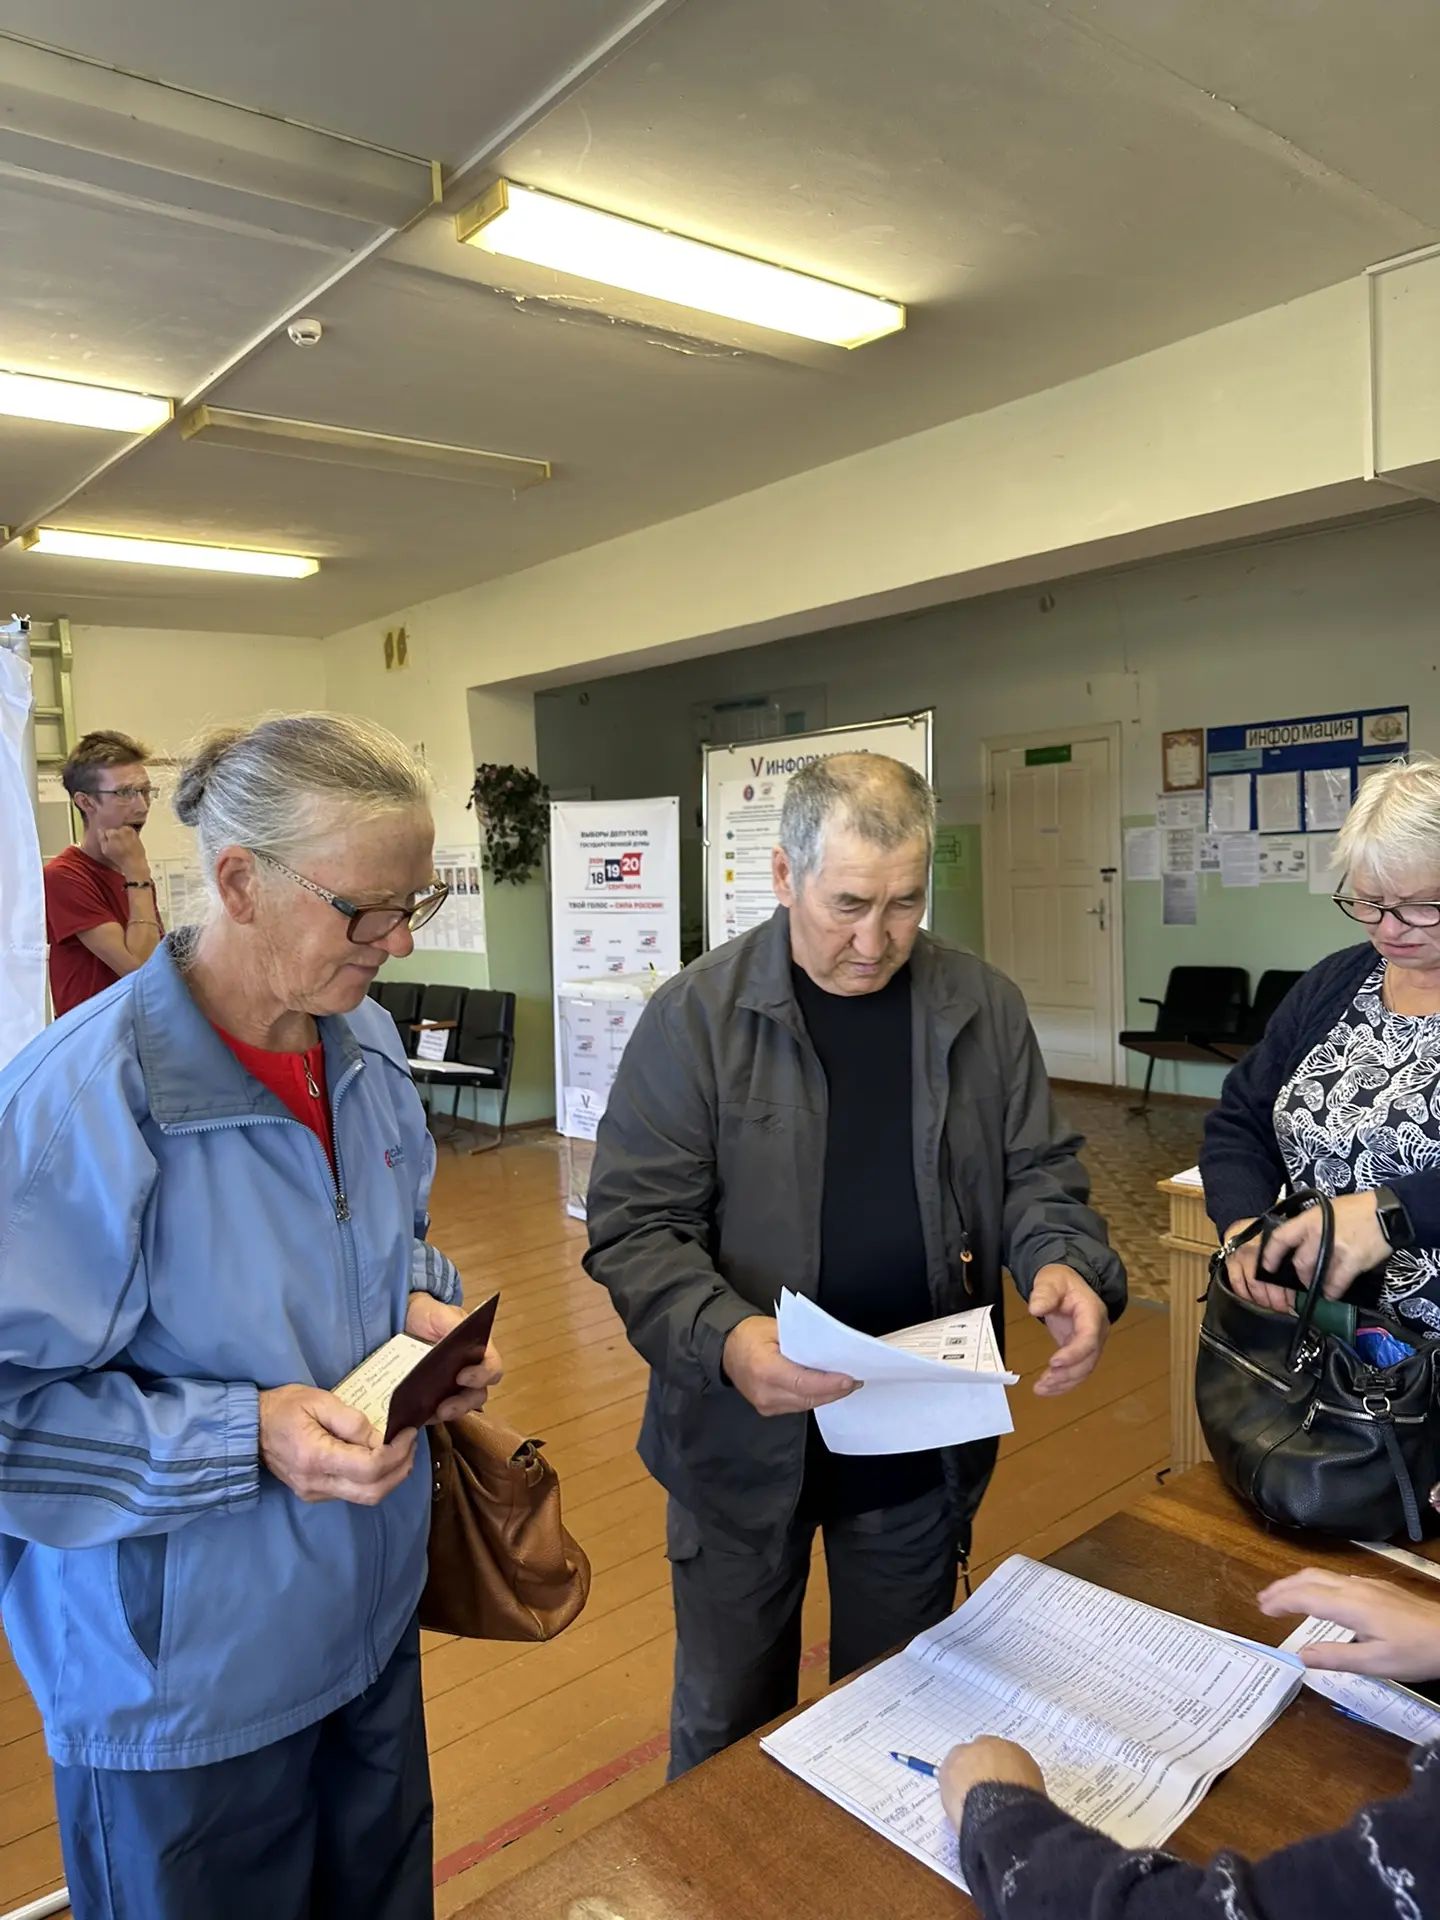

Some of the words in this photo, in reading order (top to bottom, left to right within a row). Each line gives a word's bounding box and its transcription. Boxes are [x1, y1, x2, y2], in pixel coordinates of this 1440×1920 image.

[606, 864, 620, 877] 19
[622, 858, 639, 871] 20
[592, 872, 604, 885] 18
